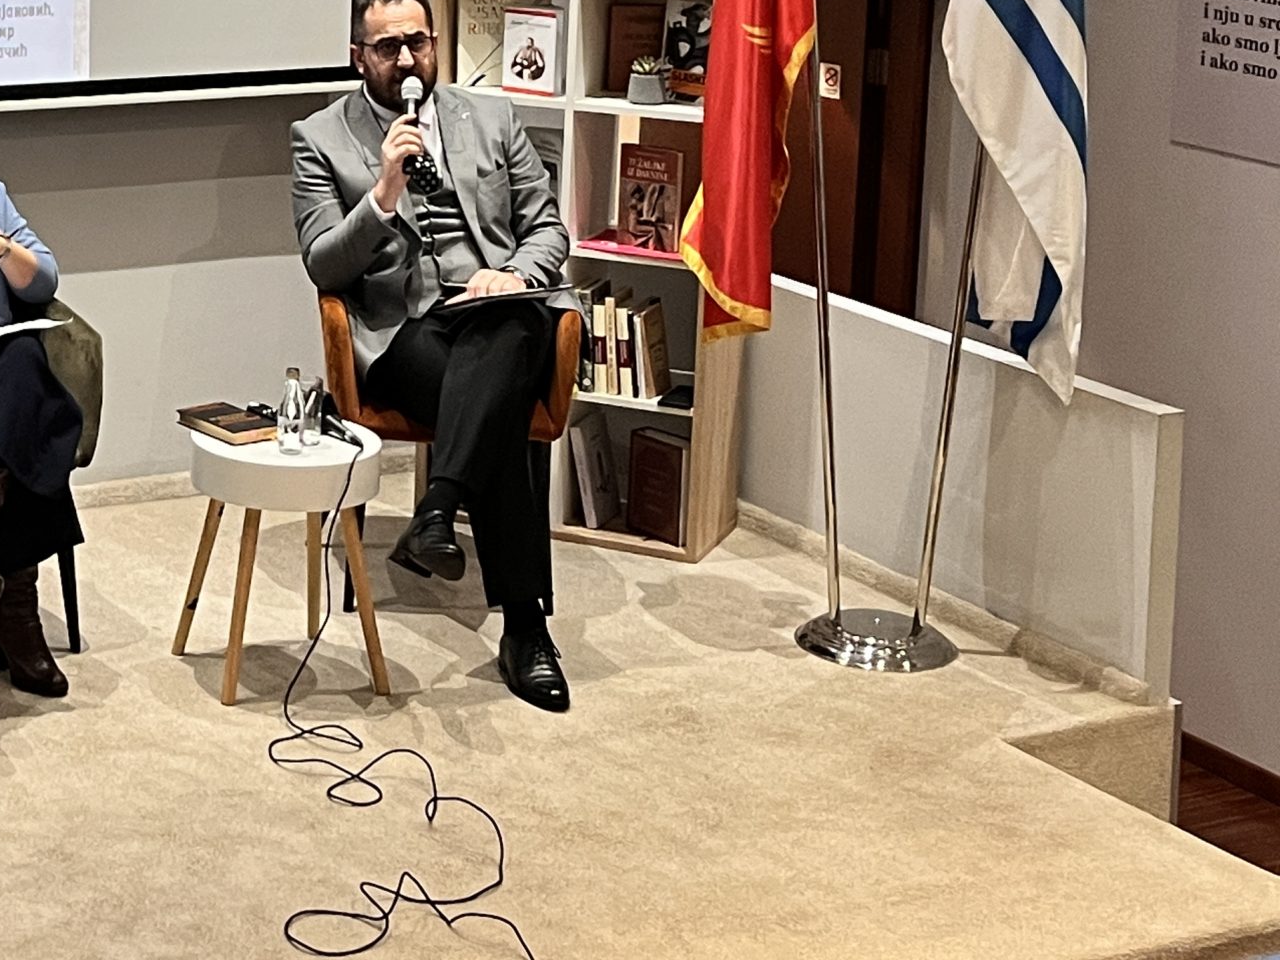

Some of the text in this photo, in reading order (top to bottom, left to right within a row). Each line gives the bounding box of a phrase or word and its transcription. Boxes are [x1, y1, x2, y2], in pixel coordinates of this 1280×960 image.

[1203, 2, 1209, 19] i
[1213, 6, 1239, 25] nju
[1244, 14, 1254, 26] u
[1202, 27, 1230, 46] ako
[1235, 36, 1269, 53] smo
[1200, 50, 1277, 80] i ako smo
